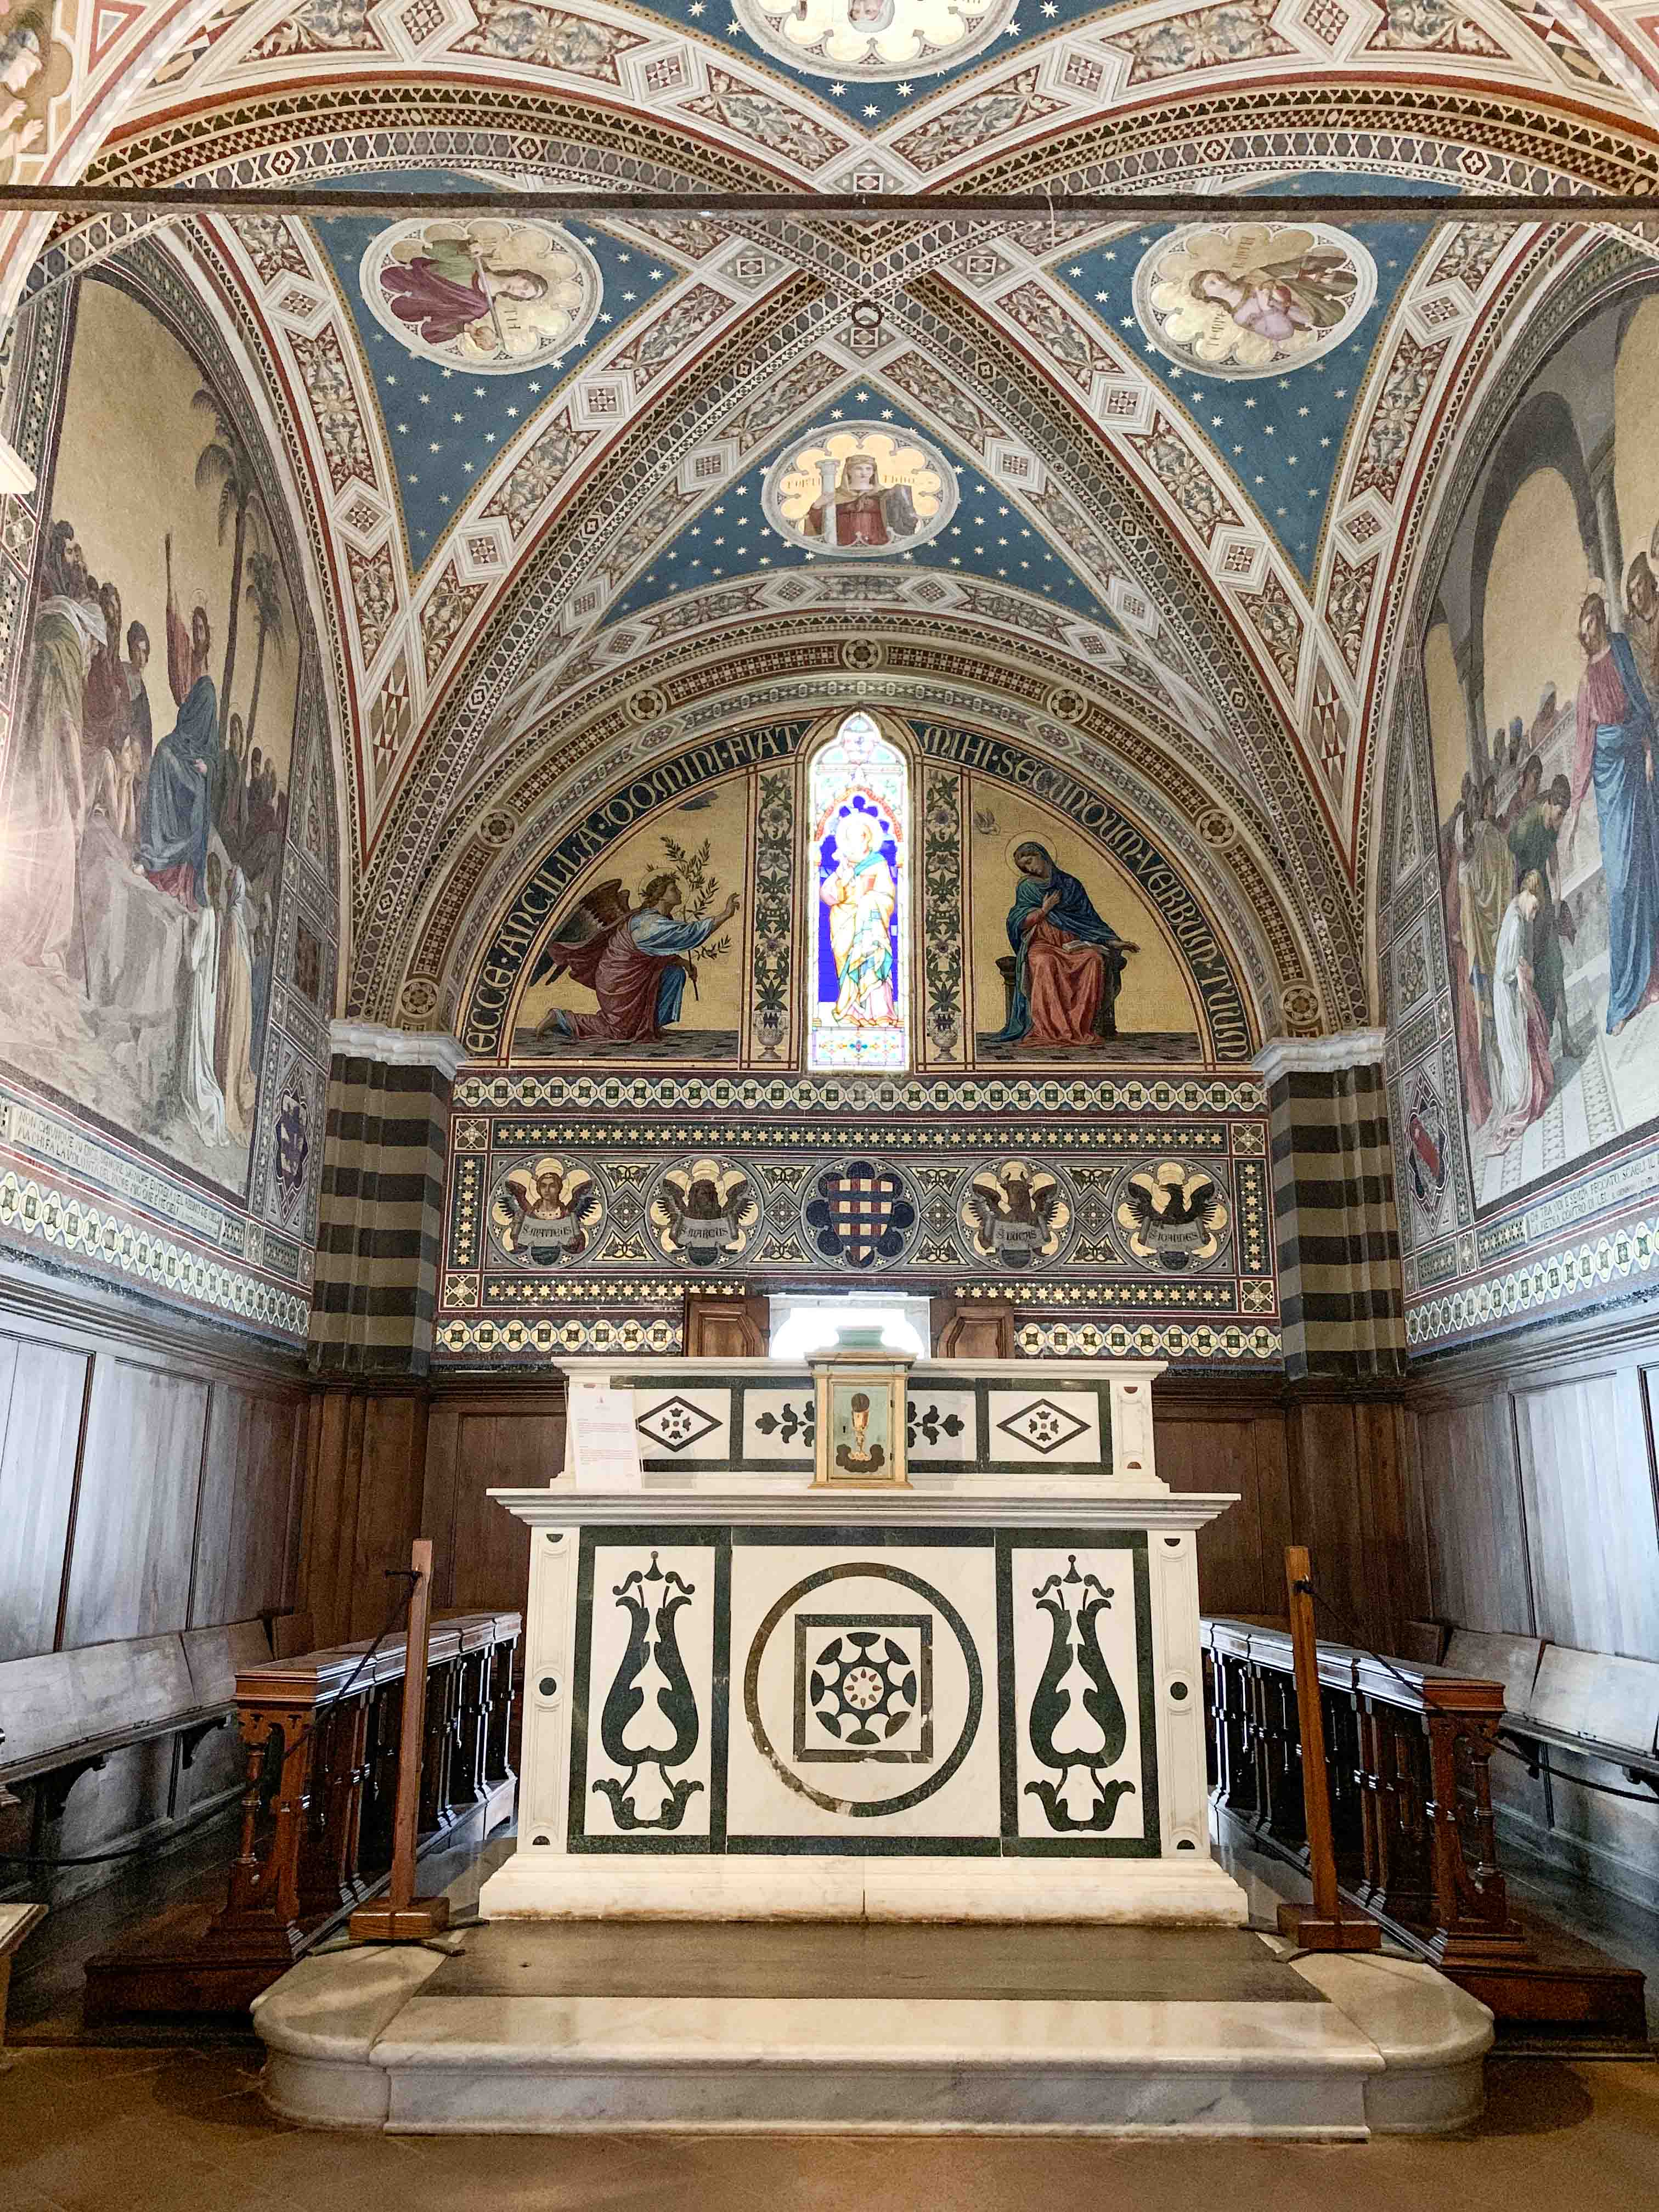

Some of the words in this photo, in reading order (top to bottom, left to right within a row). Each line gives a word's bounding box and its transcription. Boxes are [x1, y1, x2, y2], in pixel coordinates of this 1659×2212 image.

[466, 961, 516, 1052] ECCE
[495, 821, 611, 963] ANCILLA
[597, 744, 727, 826] DOMINI
[726, 725, 800, 765] FIAT
[924, 727, 994, 768] MIHI
[996, 749, 1143, 860] SECUNDUM
[1136, 849, 1217, 964] VERBUM
[1201, 967, 1249, 1058] TUUM
